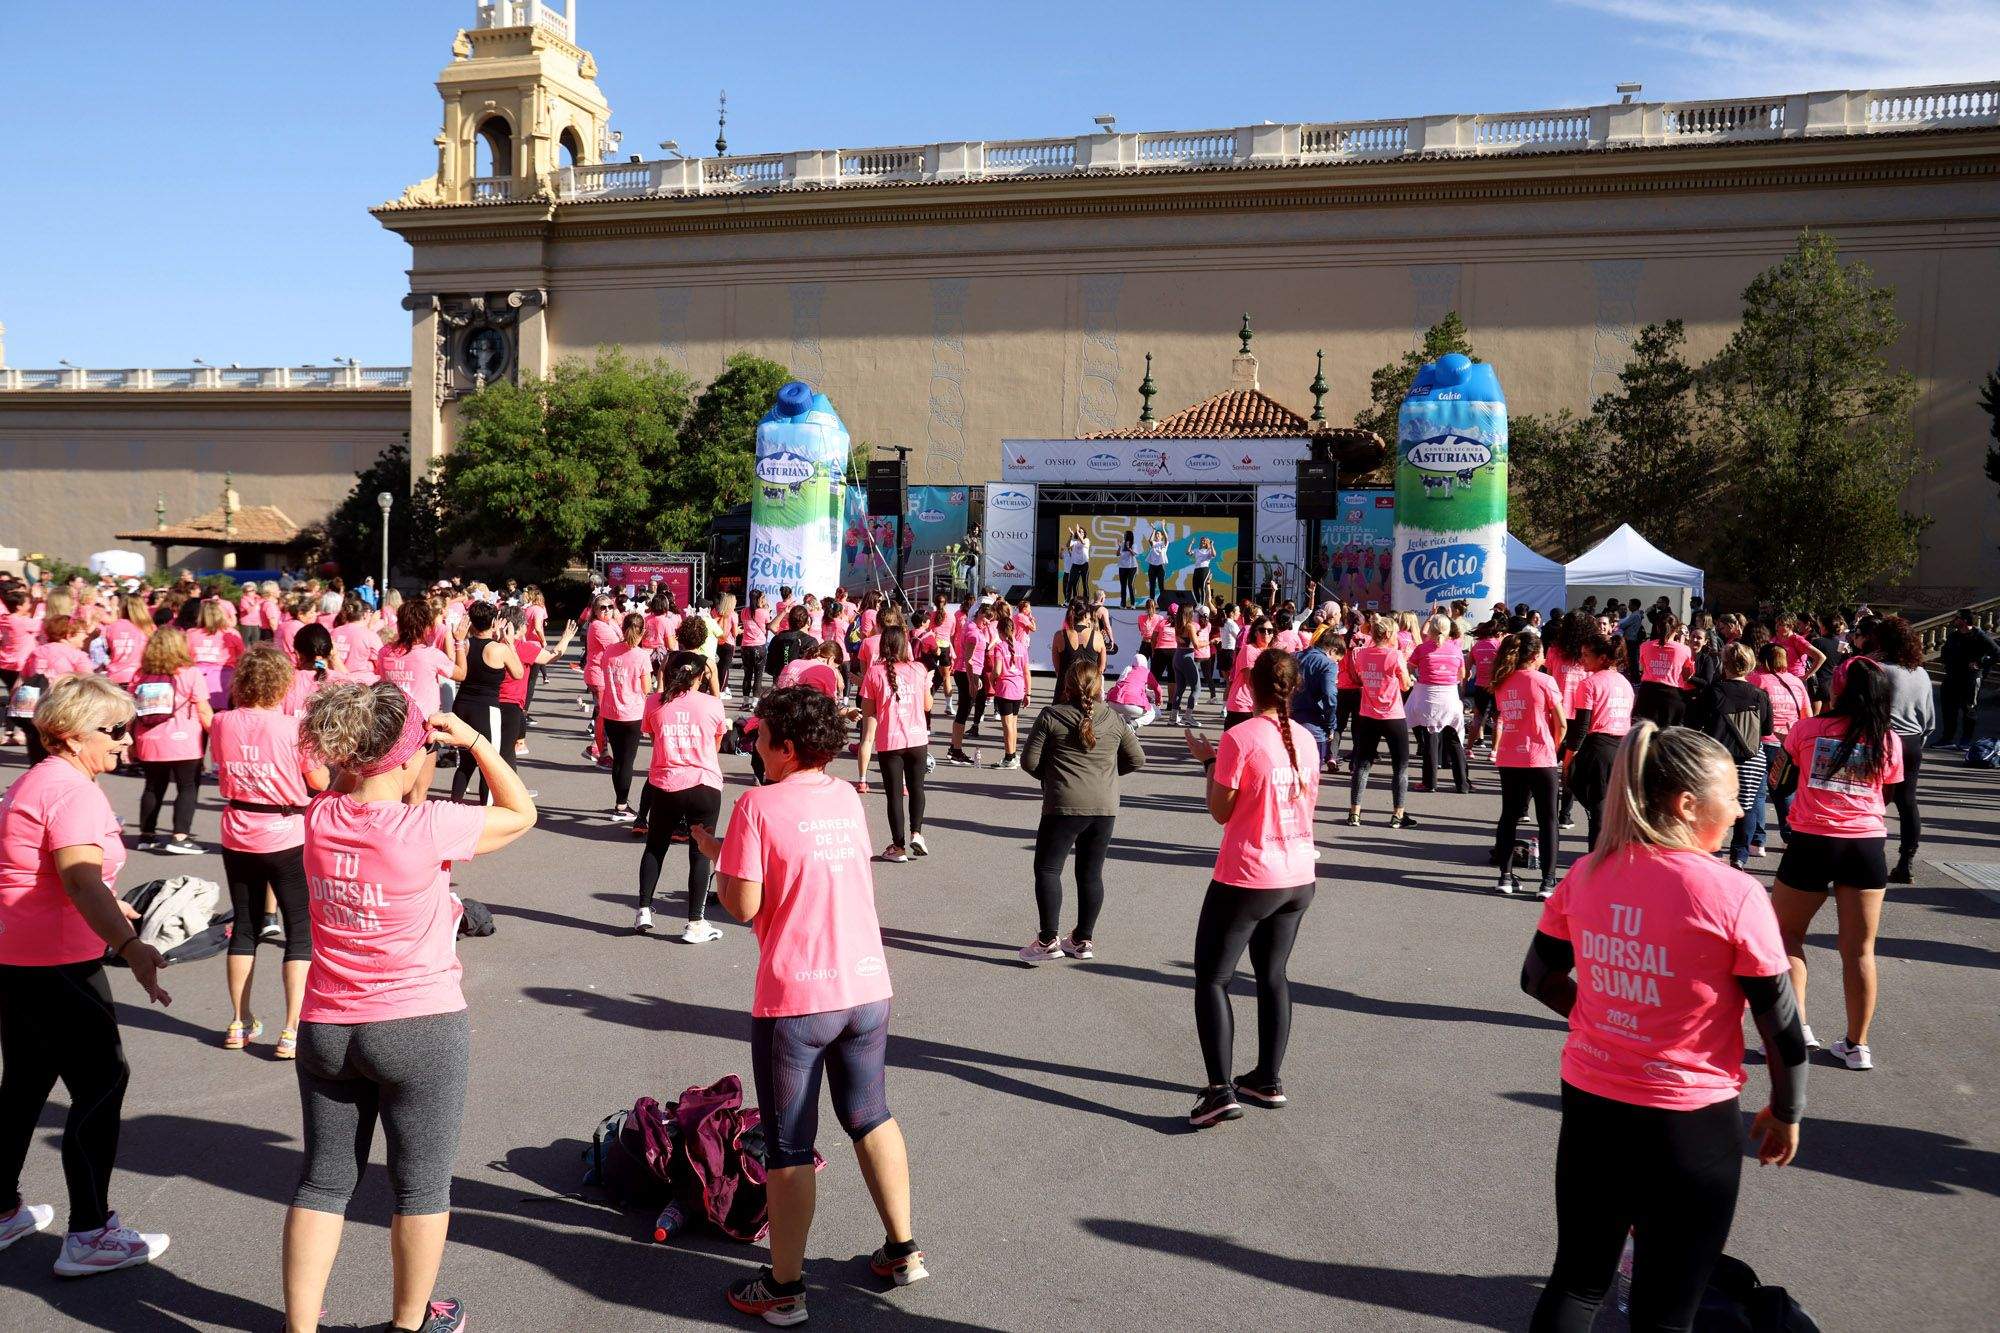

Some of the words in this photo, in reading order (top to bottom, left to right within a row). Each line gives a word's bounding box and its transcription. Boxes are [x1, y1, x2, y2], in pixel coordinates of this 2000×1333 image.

[1438, 391, 1461, 400] Calcio
[1273, 458, 1298, 466] OYSH
[1411, 448, 1485, 463] ASTURIANA
[757, 463, 809, 477] ASTURIANA
[1008, 463, 1035, 471] Santander
[1045, 458, 1076, 466] OYSHO
[995, 498, 1029, 507] ASTURIANA
[1264, 500, 1296, 508] ASTURIAN
[992, 530, 1028, 540] OYSHO
[750, 555, 806, 580] semi
[1408, 551, 1478, 584] Calcio
[1437, 582, 1475, 597] natural
[1367, 662, 1377, 672] TU
[675, 711, 690, 723] TU
[662, 724, 702, 737] DORSAL
[241, 744, 259, 760] TU
[797, 818, 859, 833] CARRERA
[815, 833, 833, 846] DE
[836, 831, 852, 844] LA
[813, 847, 856, 861] MUJER
[332, 851, 360, 879] TU
[311, 875, 391, 907] DORSAL
[323, 904, 383, 931] SUMA
[1609, 903, 1643, 936] TU
[1581, 930, 1675, 978] DORSAL
[795, 967, 838, 982] OYSHO
[1589, 964, 1662, 1008] SUMA
[1606, 1008, 1639, 1031] 2024
